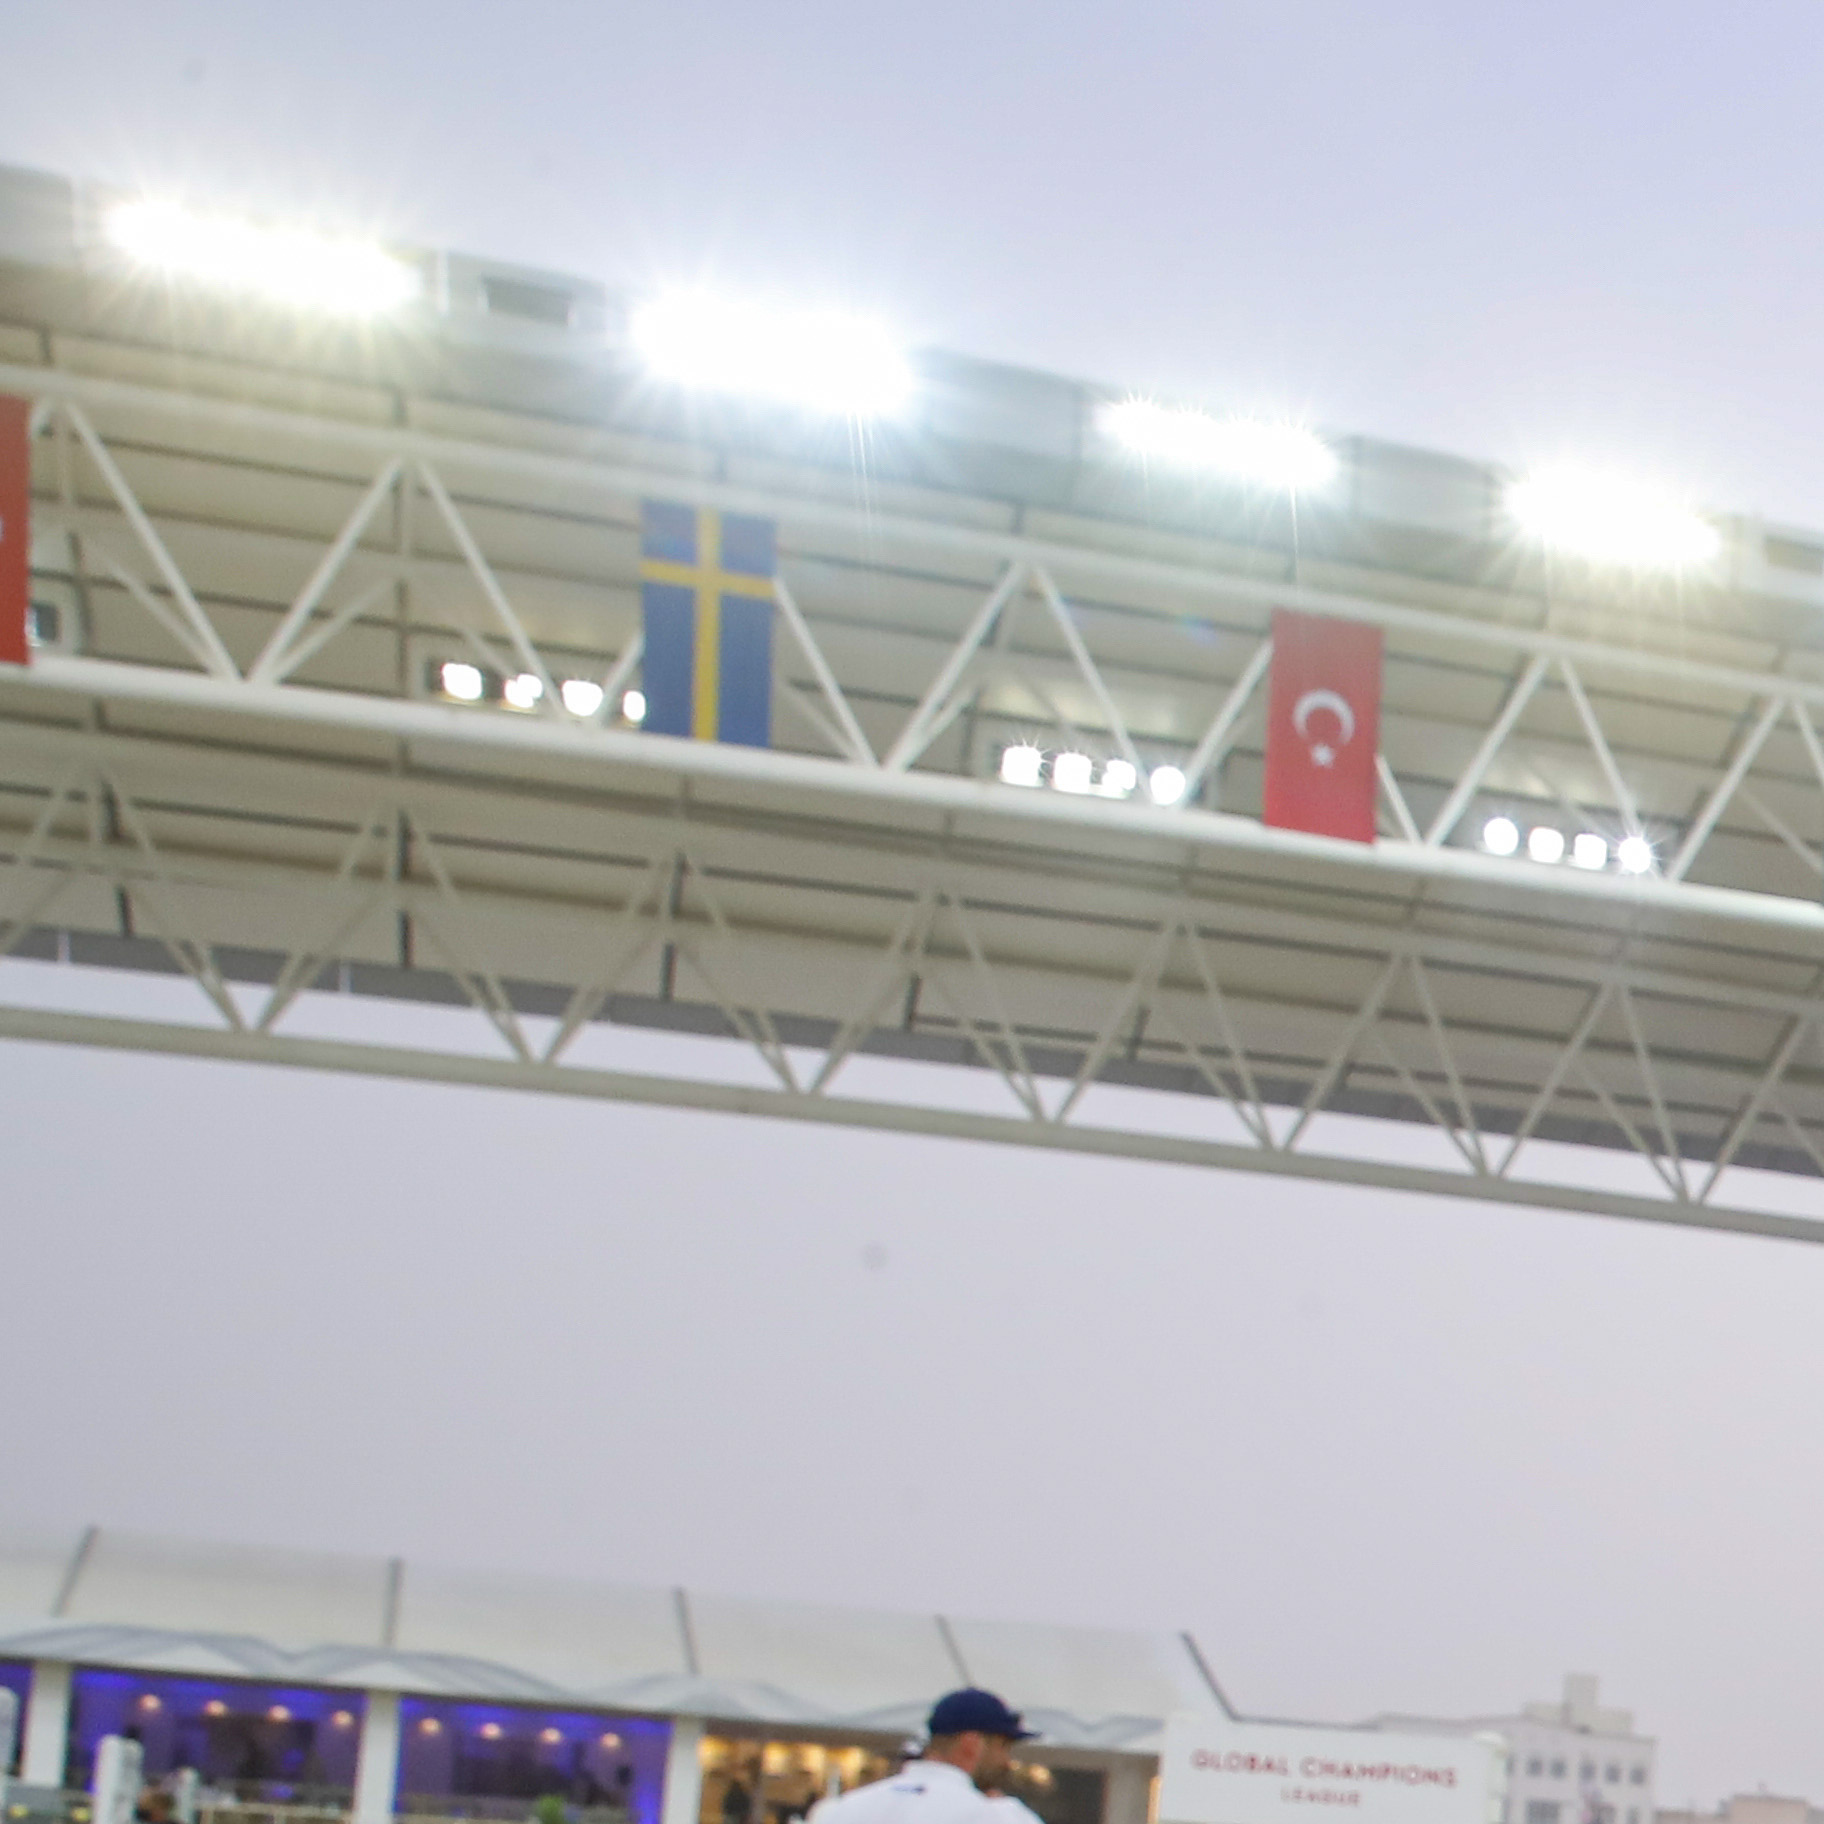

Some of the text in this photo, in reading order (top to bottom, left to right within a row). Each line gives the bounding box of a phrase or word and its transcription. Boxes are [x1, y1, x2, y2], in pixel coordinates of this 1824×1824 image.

[1190, 1749, 1458, 1788] GLOBAL CHAMPIONS
[1280, 1787, 1361, 1805] LEAGUE
